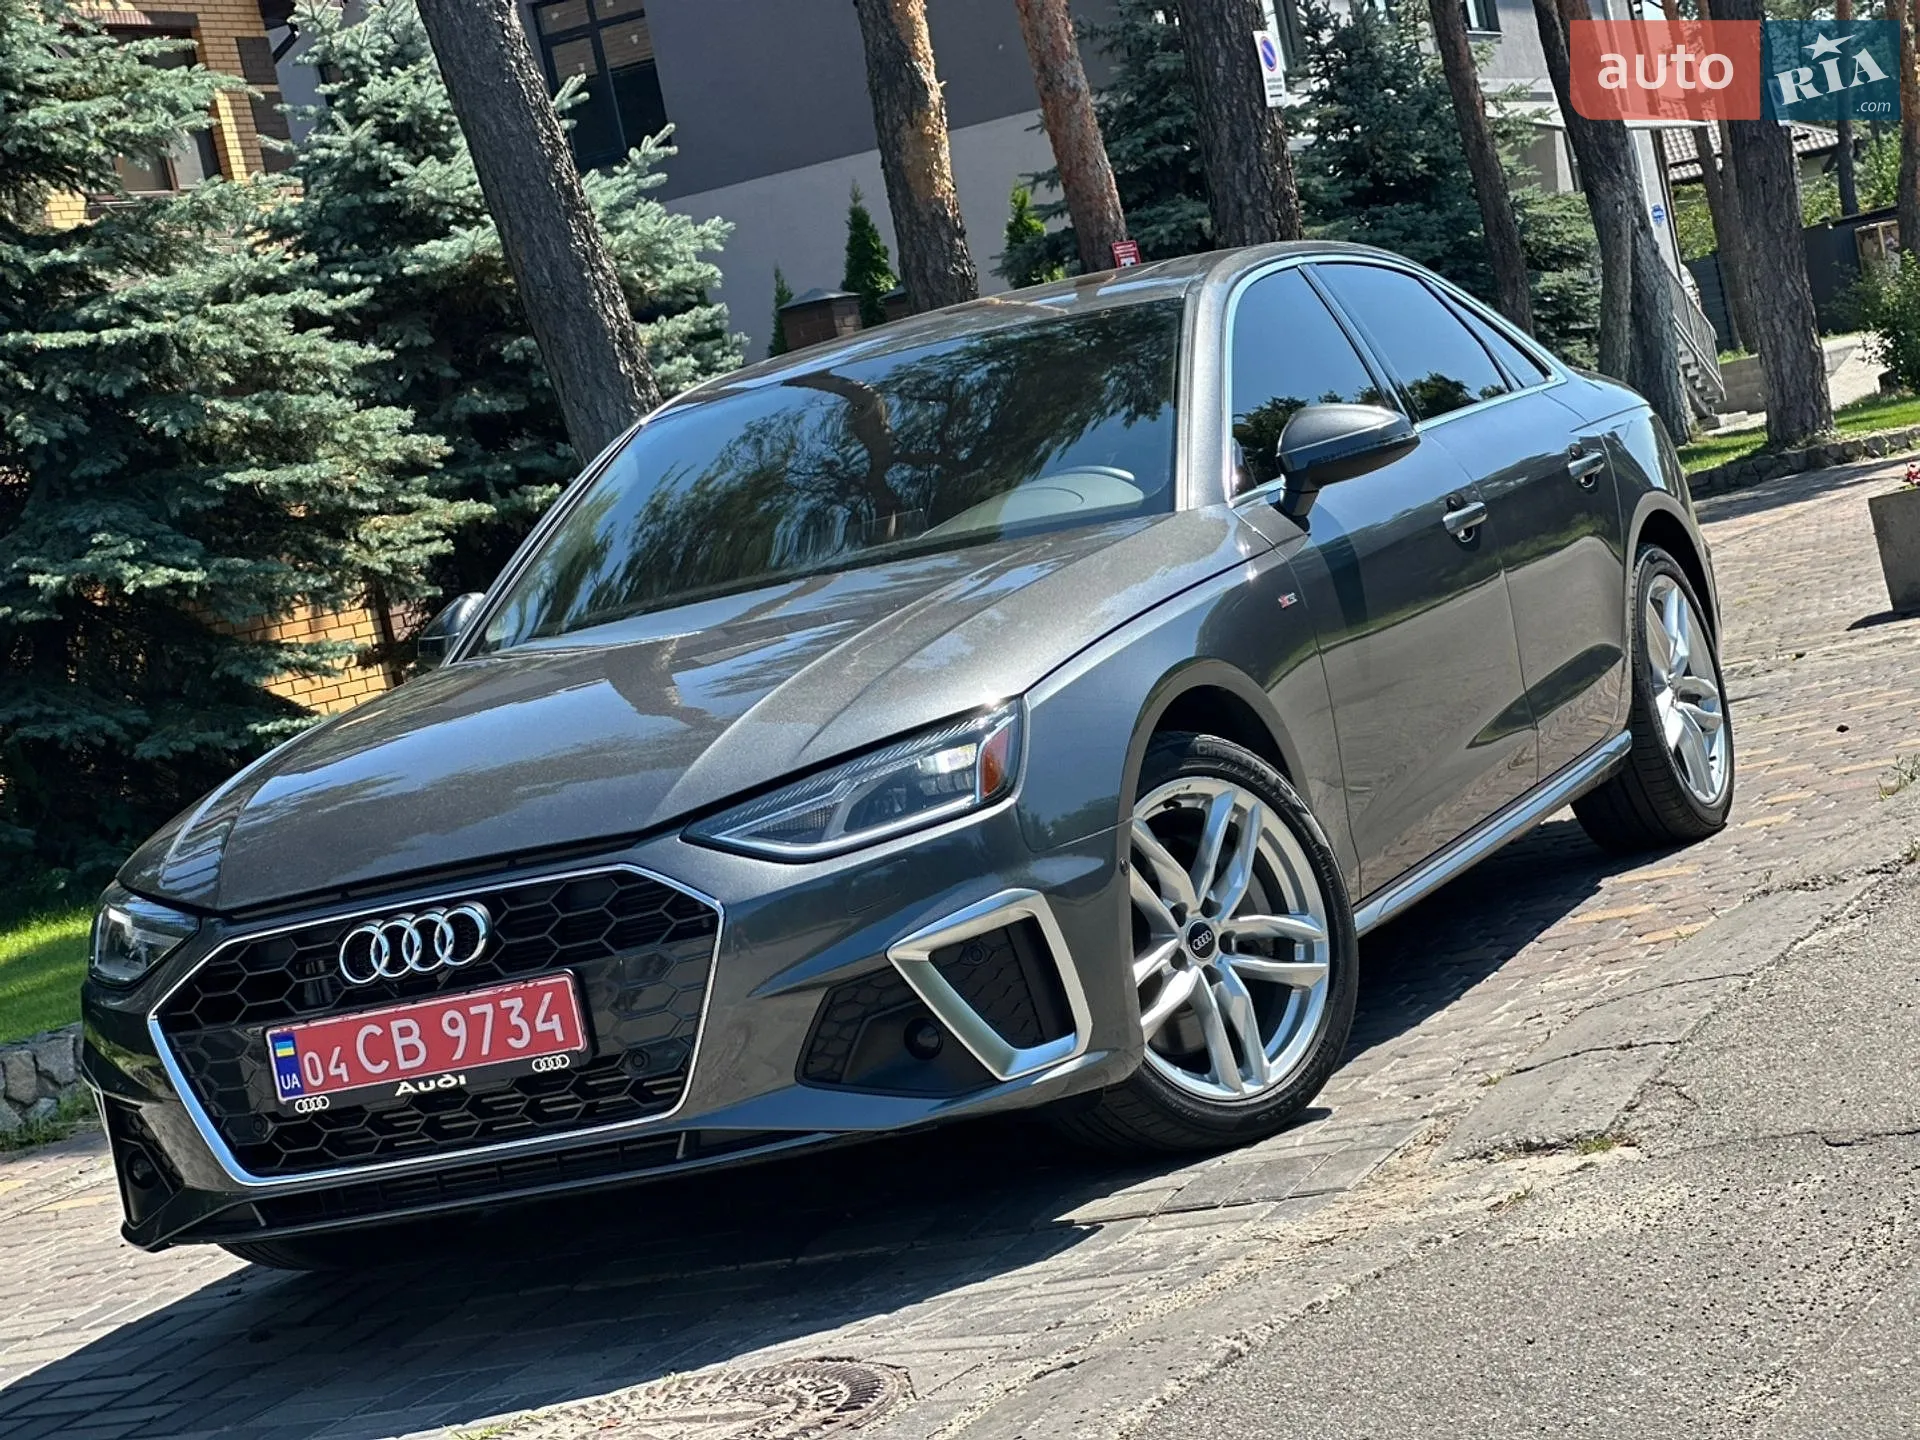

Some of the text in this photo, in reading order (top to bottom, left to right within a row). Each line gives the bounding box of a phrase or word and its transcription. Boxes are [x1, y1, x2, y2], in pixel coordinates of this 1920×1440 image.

[303, 991, 564, 1087] 04 CB 9734
[281, 1073, 301, 1091] UA
[394, 1074, 467, 1097] Audi
